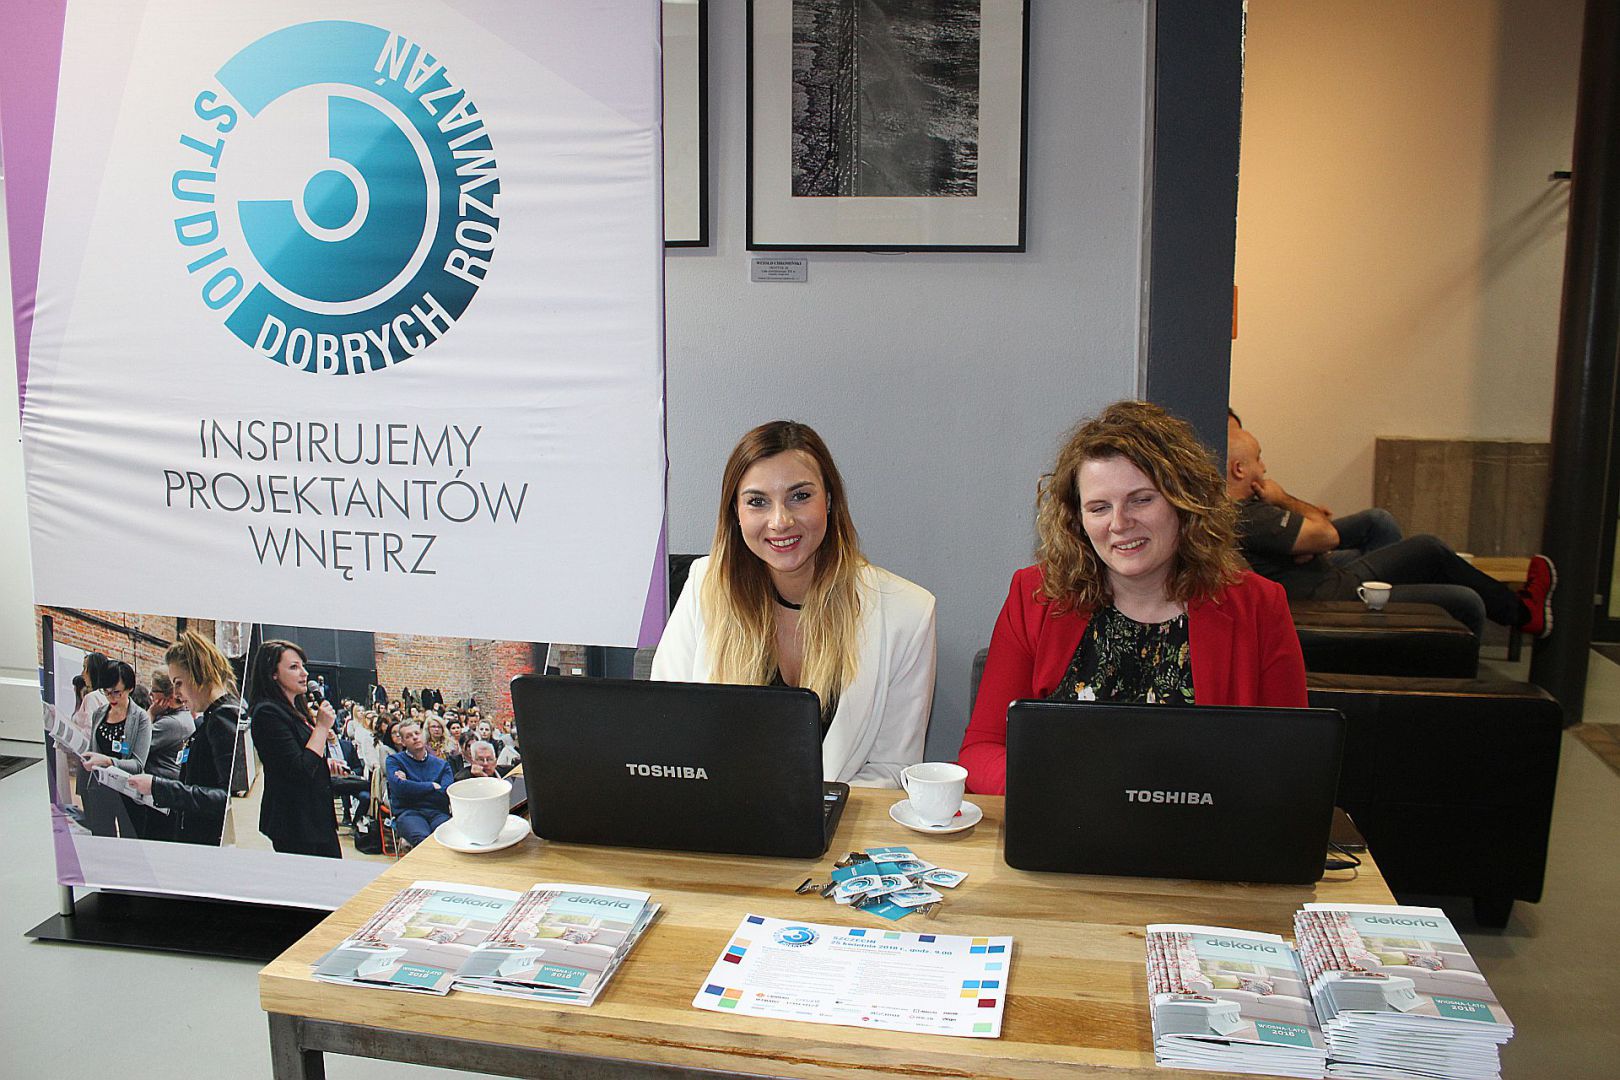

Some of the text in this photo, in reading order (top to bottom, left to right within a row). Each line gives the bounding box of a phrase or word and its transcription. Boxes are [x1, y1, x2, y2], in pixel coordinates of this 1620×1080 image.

[172, 89, 244, 311] STUDIO
[253, 292, 455, 375] DOBRYCH
[199, 419, 482, 467] INSPIRUJEMY
[164, 469, 529, 524] PROJEKTANTÓW
[248, 525, 437, 580] WNĘTRZ
[626, 763, 708, 780] TOSHIBA
[1125, 789, 1214, 805] TOSHIBA
[440, 894, 503, 910] dekoria
[567, 895, 631, 910] dekoria
[1364, 915, 1439, 928] dekoria
[1206, 938, 1277, 954] dekoria
